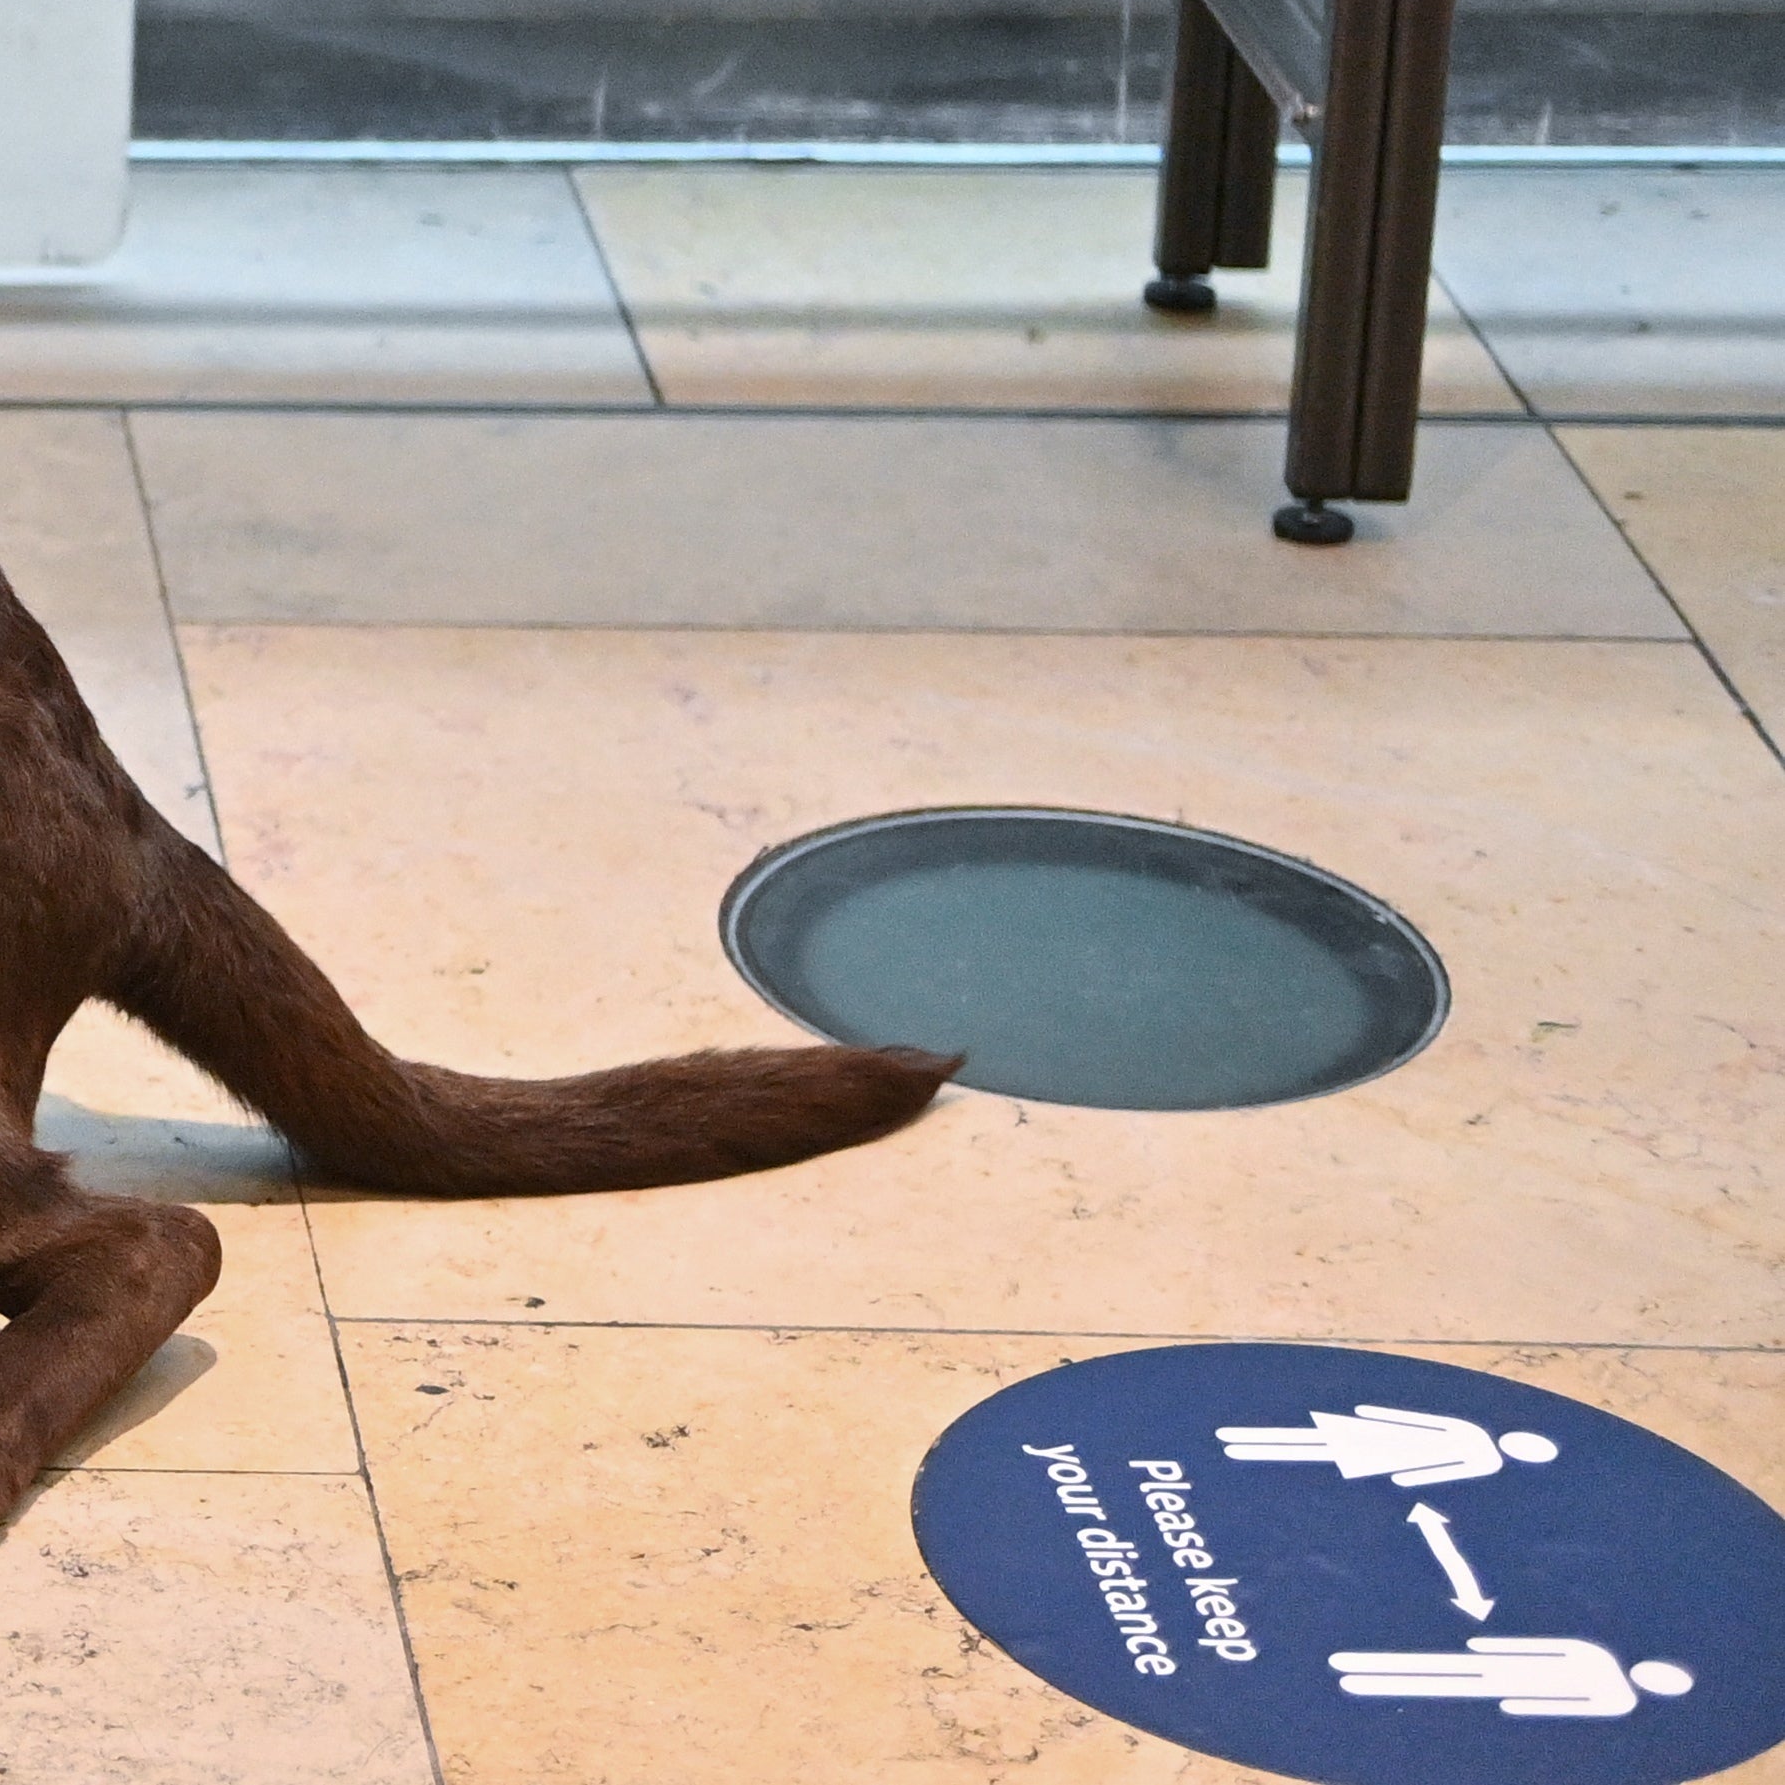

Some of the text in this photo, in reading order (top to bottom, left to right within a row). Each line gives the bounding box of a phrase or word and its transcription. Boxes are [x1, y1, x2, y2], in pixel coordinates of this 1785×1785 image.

[1021, 1443, 1177, 1676] your distance
[1128, 1460, 1257, 1662] Please keep
